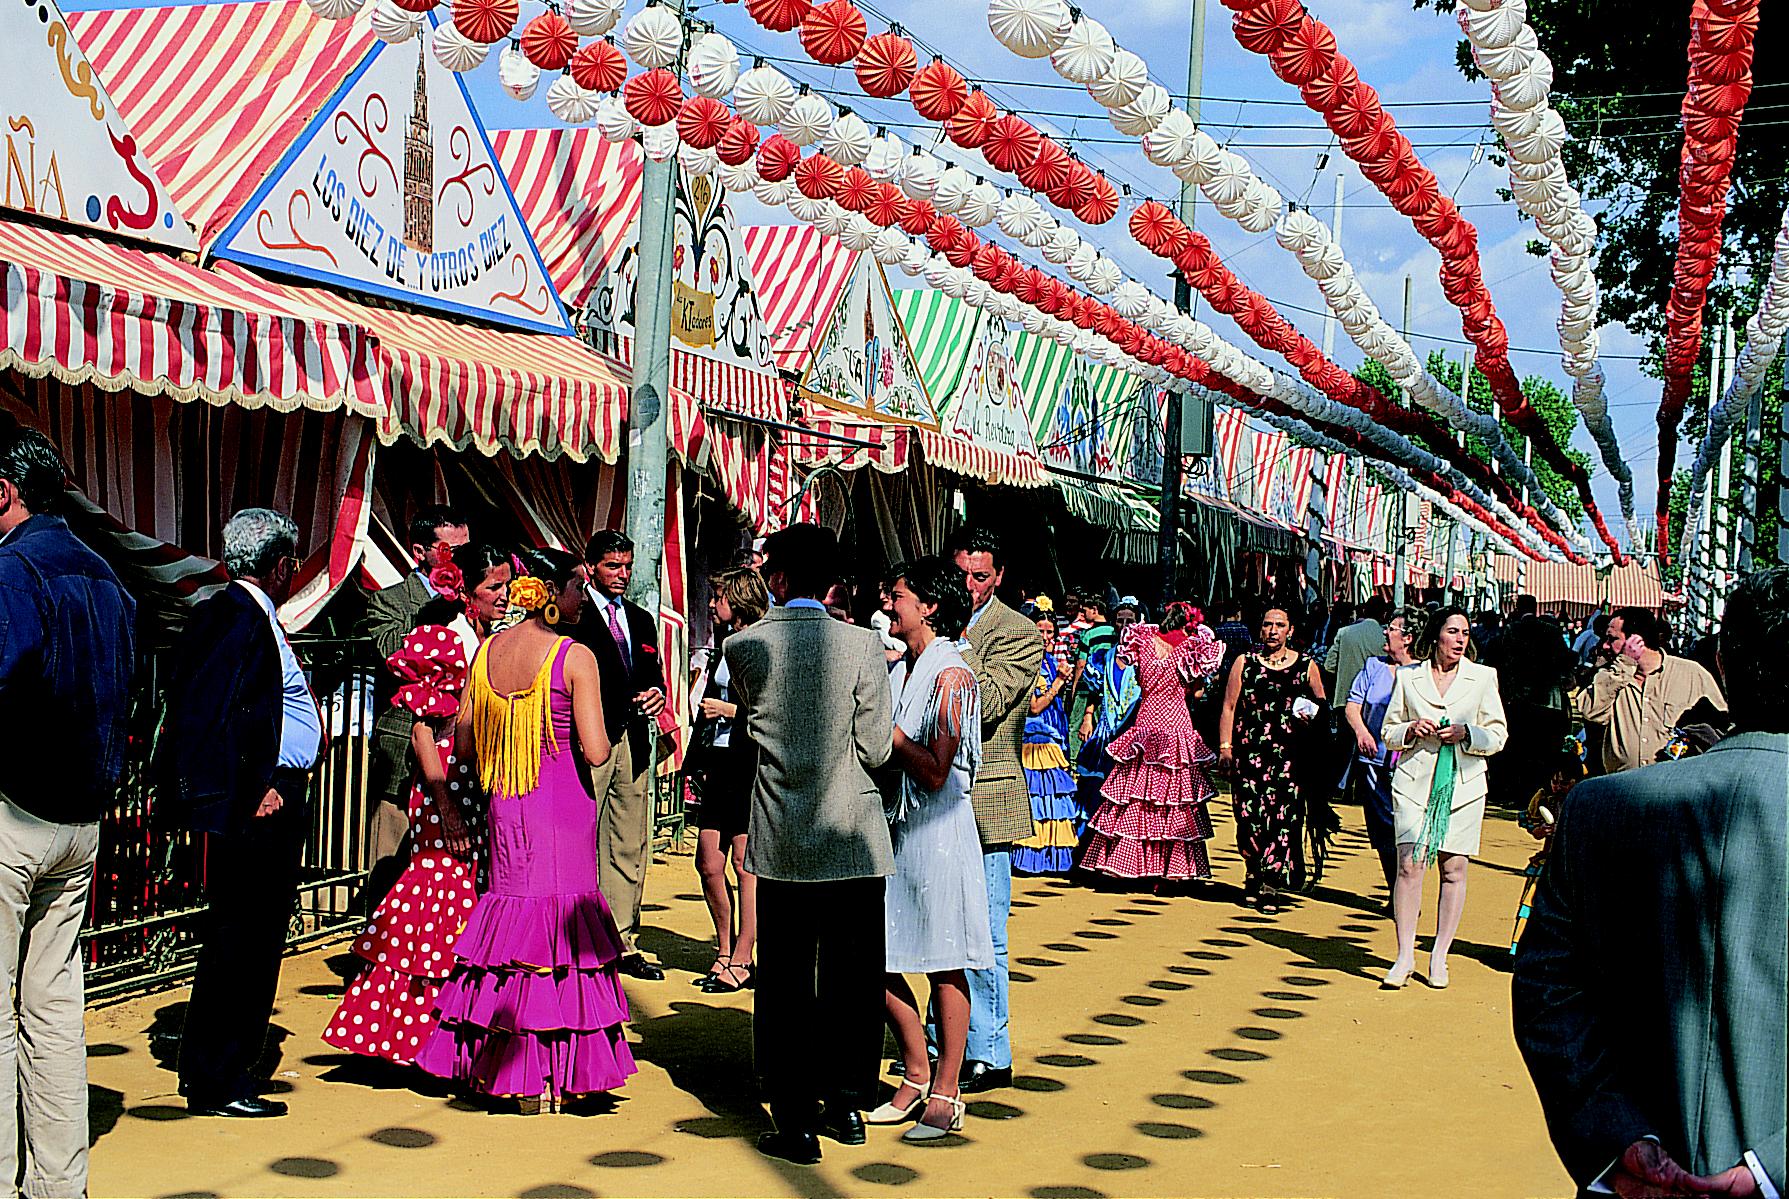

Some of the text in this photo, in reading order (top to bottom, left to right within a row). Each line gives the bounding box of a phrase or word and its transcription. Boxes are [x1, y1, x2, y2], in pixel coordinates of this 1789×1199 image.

[312, 153, 346, 222] LOS
[345, 196, 385, 268] DIEZ
[416, 252, 428, 290] Y
[431, 242, 479, 292] OTROS
[479, 213, 512, 272] DIEZ
